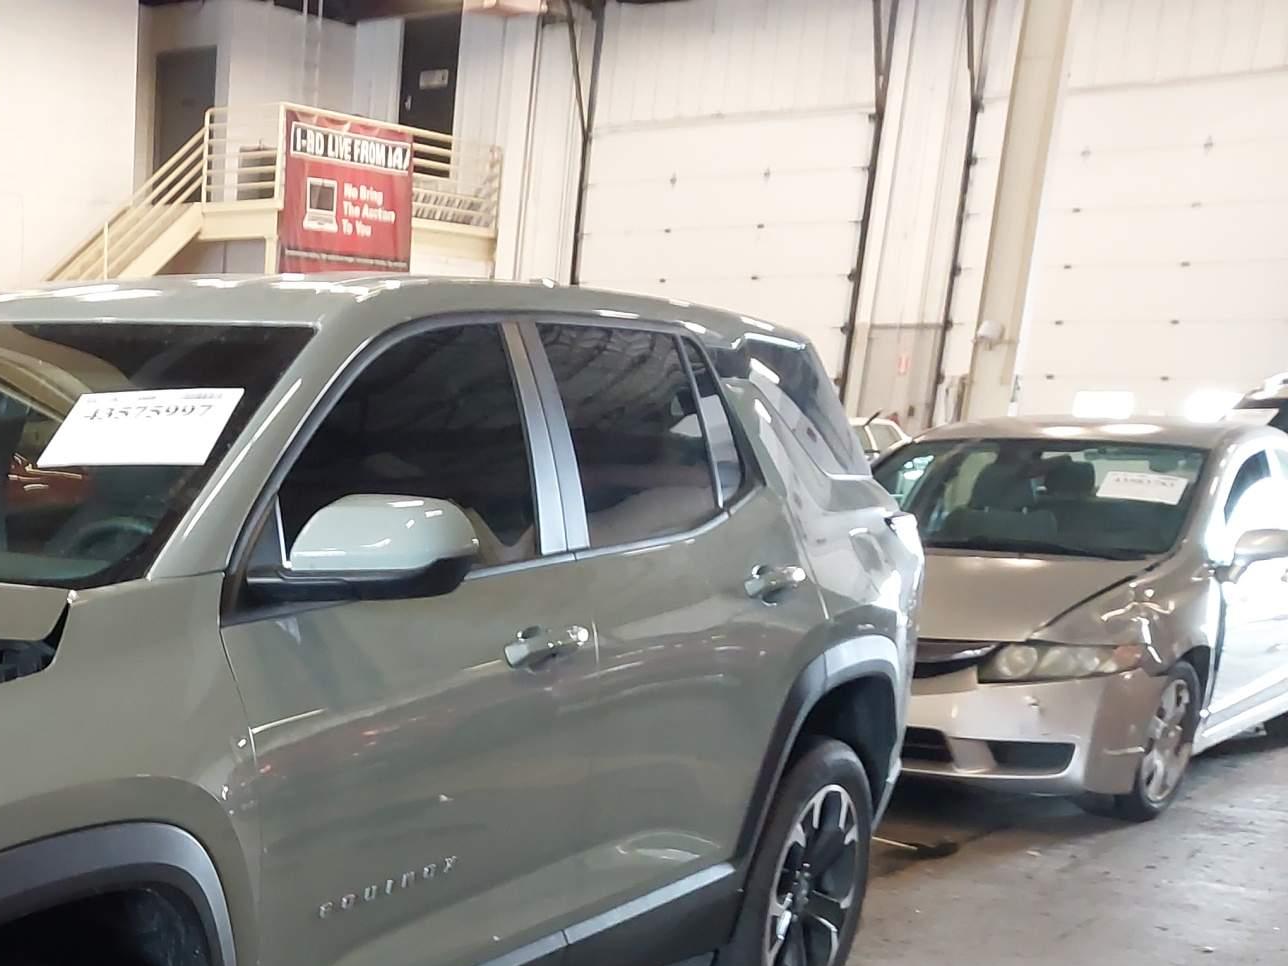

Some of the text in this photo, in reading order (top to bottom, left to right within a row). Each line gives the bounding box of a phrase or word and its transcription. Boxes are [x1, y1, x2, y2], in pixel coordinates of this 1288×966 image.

[327, 133, 352, 162] LIVE
[353, 139, 386, 167] FROM
[320, 855, 457, 919] EQUINOX
